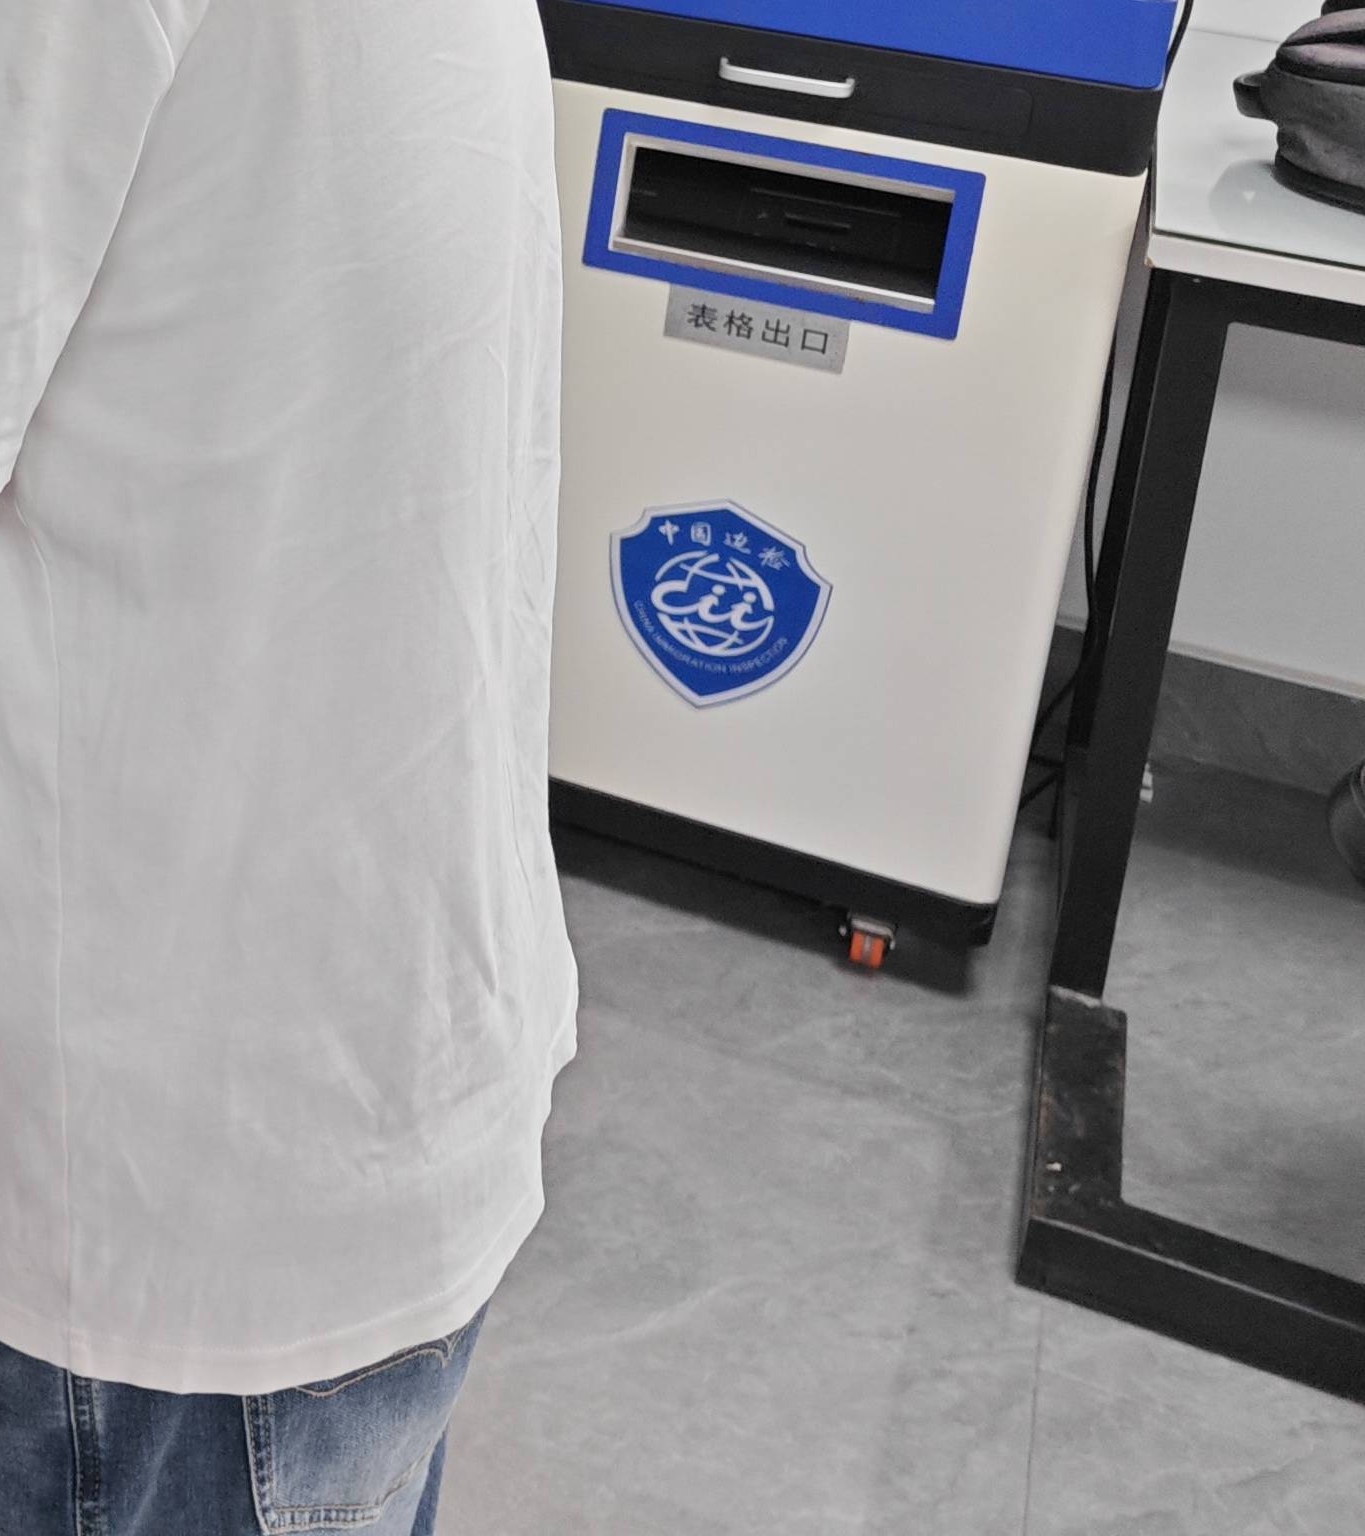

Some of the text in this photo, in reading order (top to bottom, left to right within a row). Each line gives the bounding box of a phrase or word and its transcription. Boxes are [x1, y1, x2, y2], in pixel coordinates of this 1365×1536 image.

[687, 303, 828, 354] 表格出口
[658, 519, 790, 571] 中国边检
[633, 599, 655, 633] CHINA
[729, 636, 789, 674] INSPECTION
